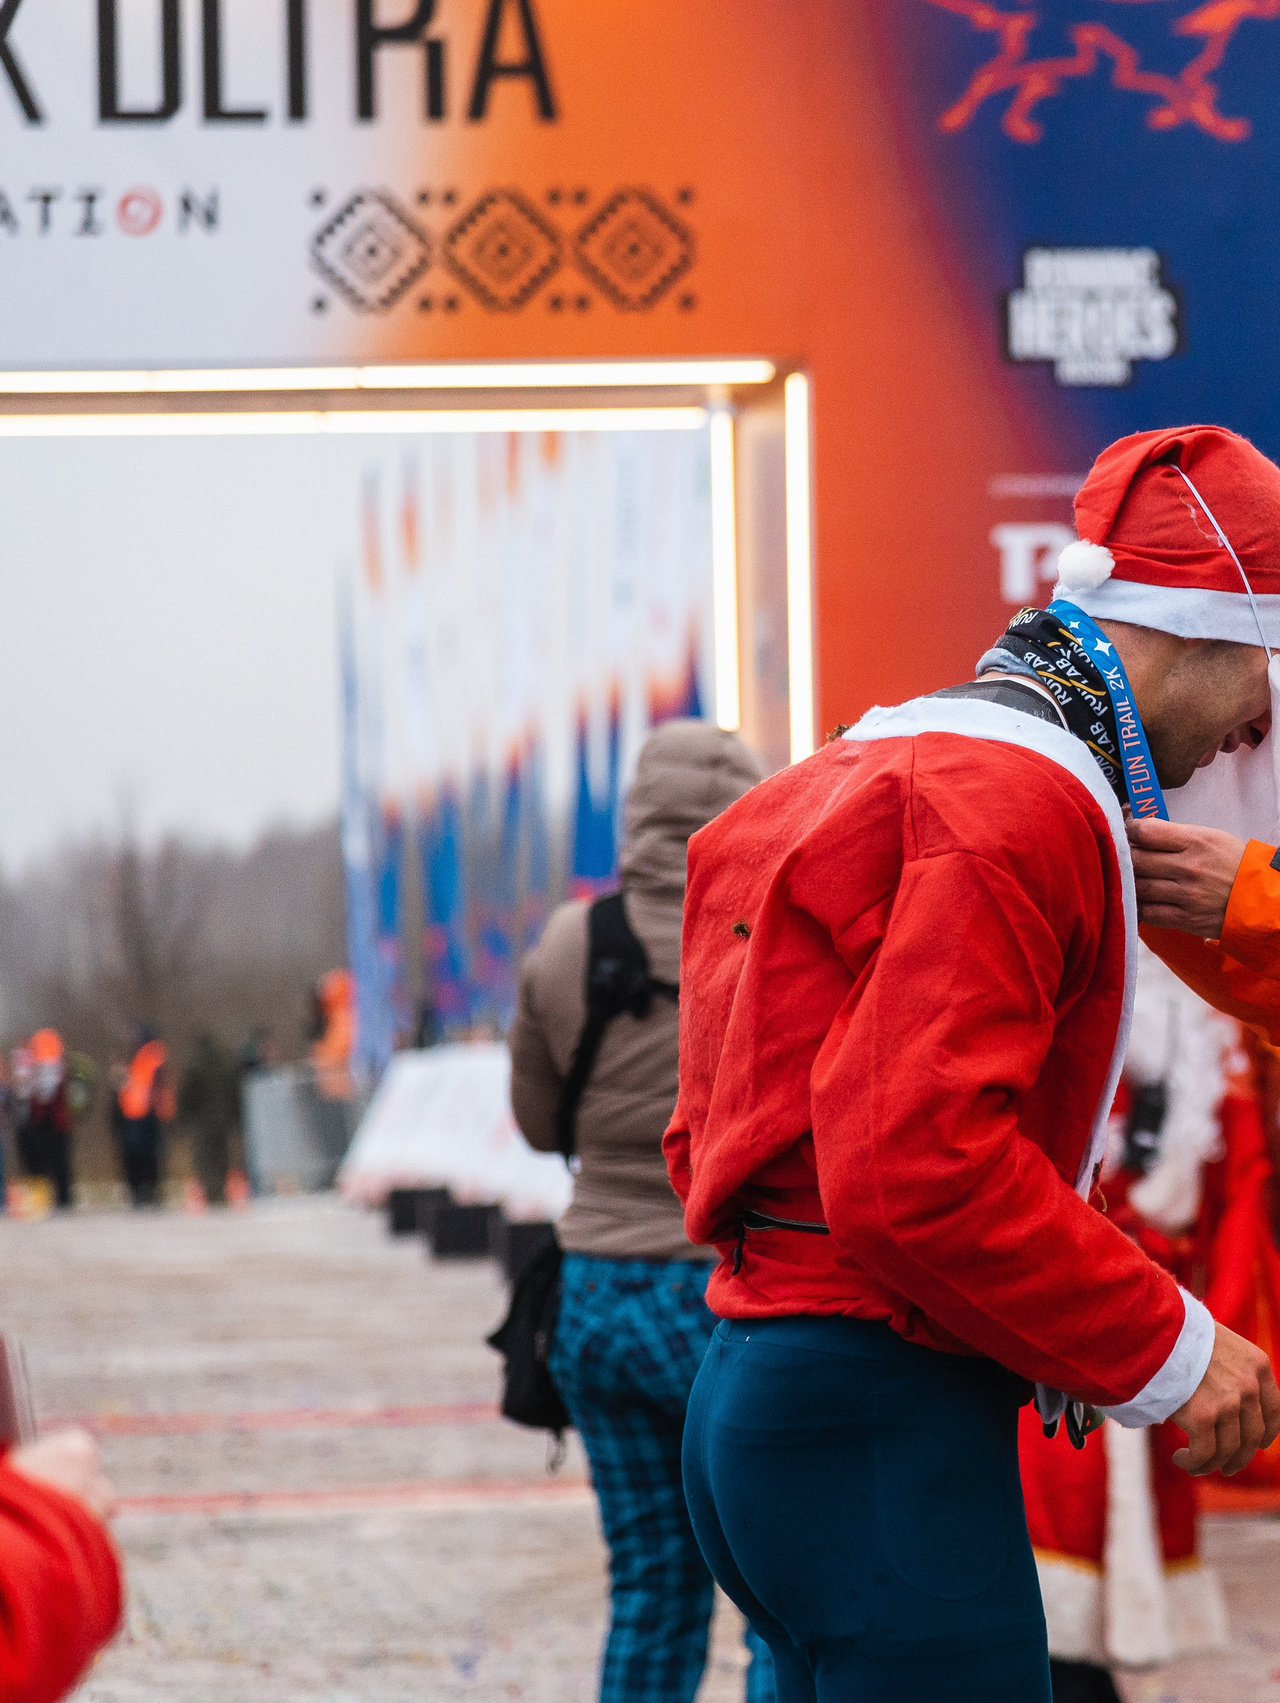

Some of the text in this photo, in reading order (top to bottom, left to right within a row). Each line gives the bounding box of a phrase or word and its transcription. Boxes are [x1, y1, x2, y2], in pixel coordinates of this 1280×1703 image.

[1102, 666, 1125, 691] 2K
[1116, 696, 1141, 751] TRAIL
[1127, 755, 1153, 794] FUN
